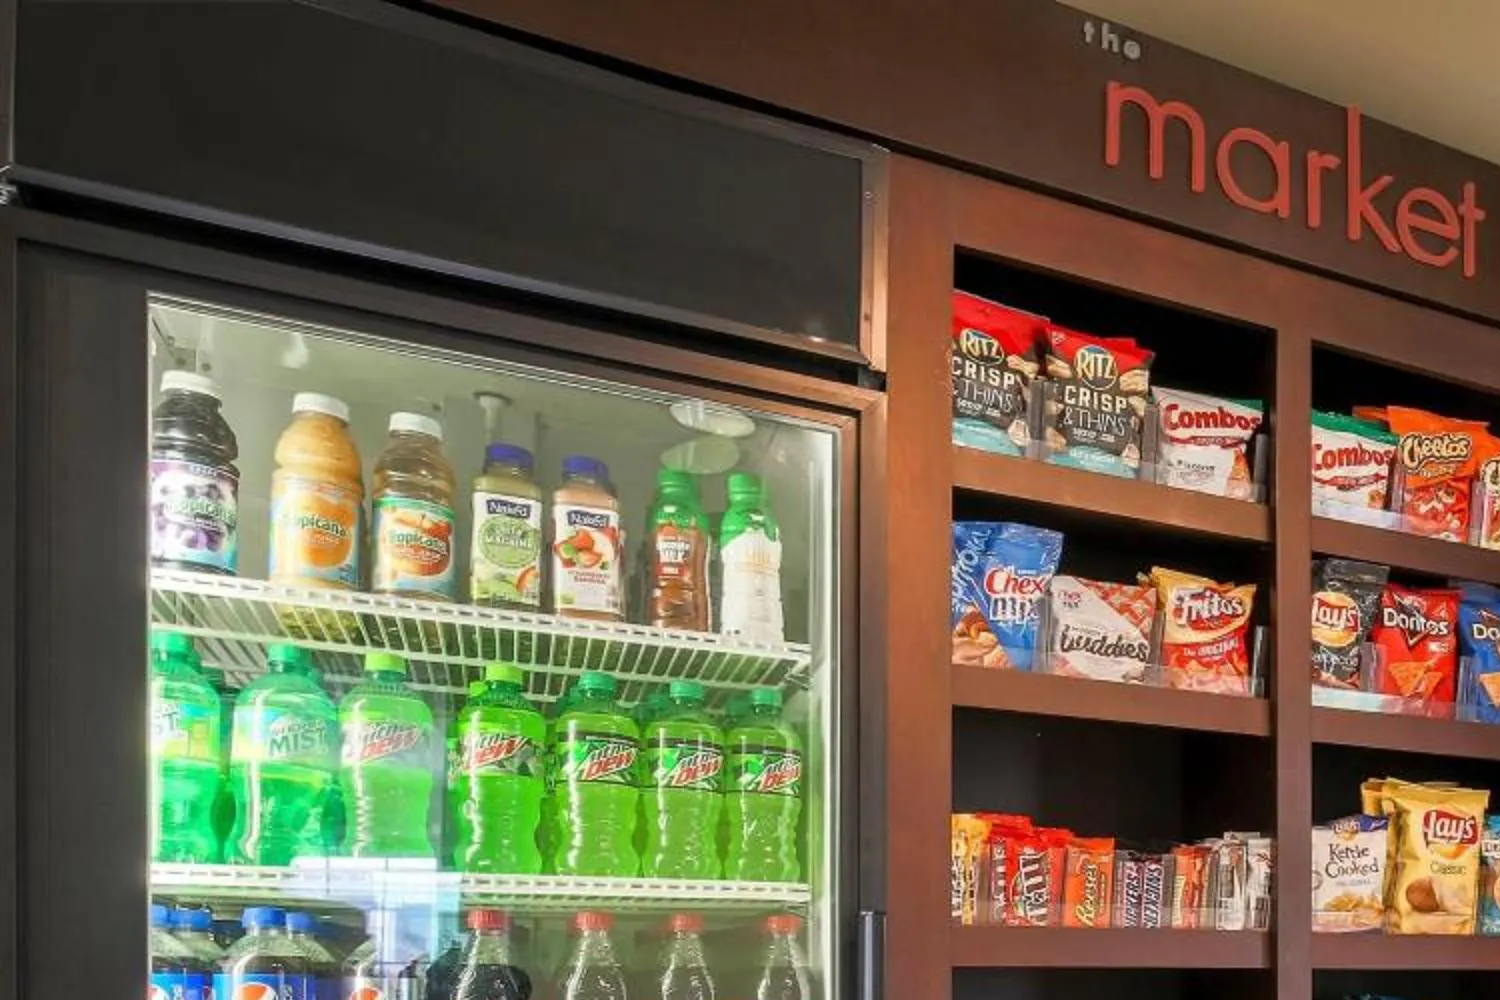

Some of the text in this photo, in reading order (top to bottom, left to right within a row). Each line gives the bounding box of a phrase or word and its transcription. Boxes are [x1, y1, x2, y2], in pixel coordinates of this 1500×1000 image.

[1083, 19, 1141, 62] the
[1105, 80, 1486, 278] market
[961, 328, 1003, 358] RITZ
[952, 355, 1015, 390] CRISP
[1075, 348, 1116, 381] RITZ
[959, 379, 1014, 413] THINS
[1064, 384, 1129, 414] CRISP
[1063, 407, 1076, 426] &
[1077, 408, 1127, 437] THINS
[1163, 402, 1263, 431] Combos
[1402, 433, 1471, 470] Cheetos
[284, 510, 348, 537] opicana
[985, 568, 1046, 596] Chex
[1172, 587, 1244, 625] Fritos
[1382, 607, 1449, 636] Doritos
[1424, 809, 1477, 844] Lay's
[1327, 842, 1370, 862] Kettle
[1325, 857, 1380, 879] Cooked
